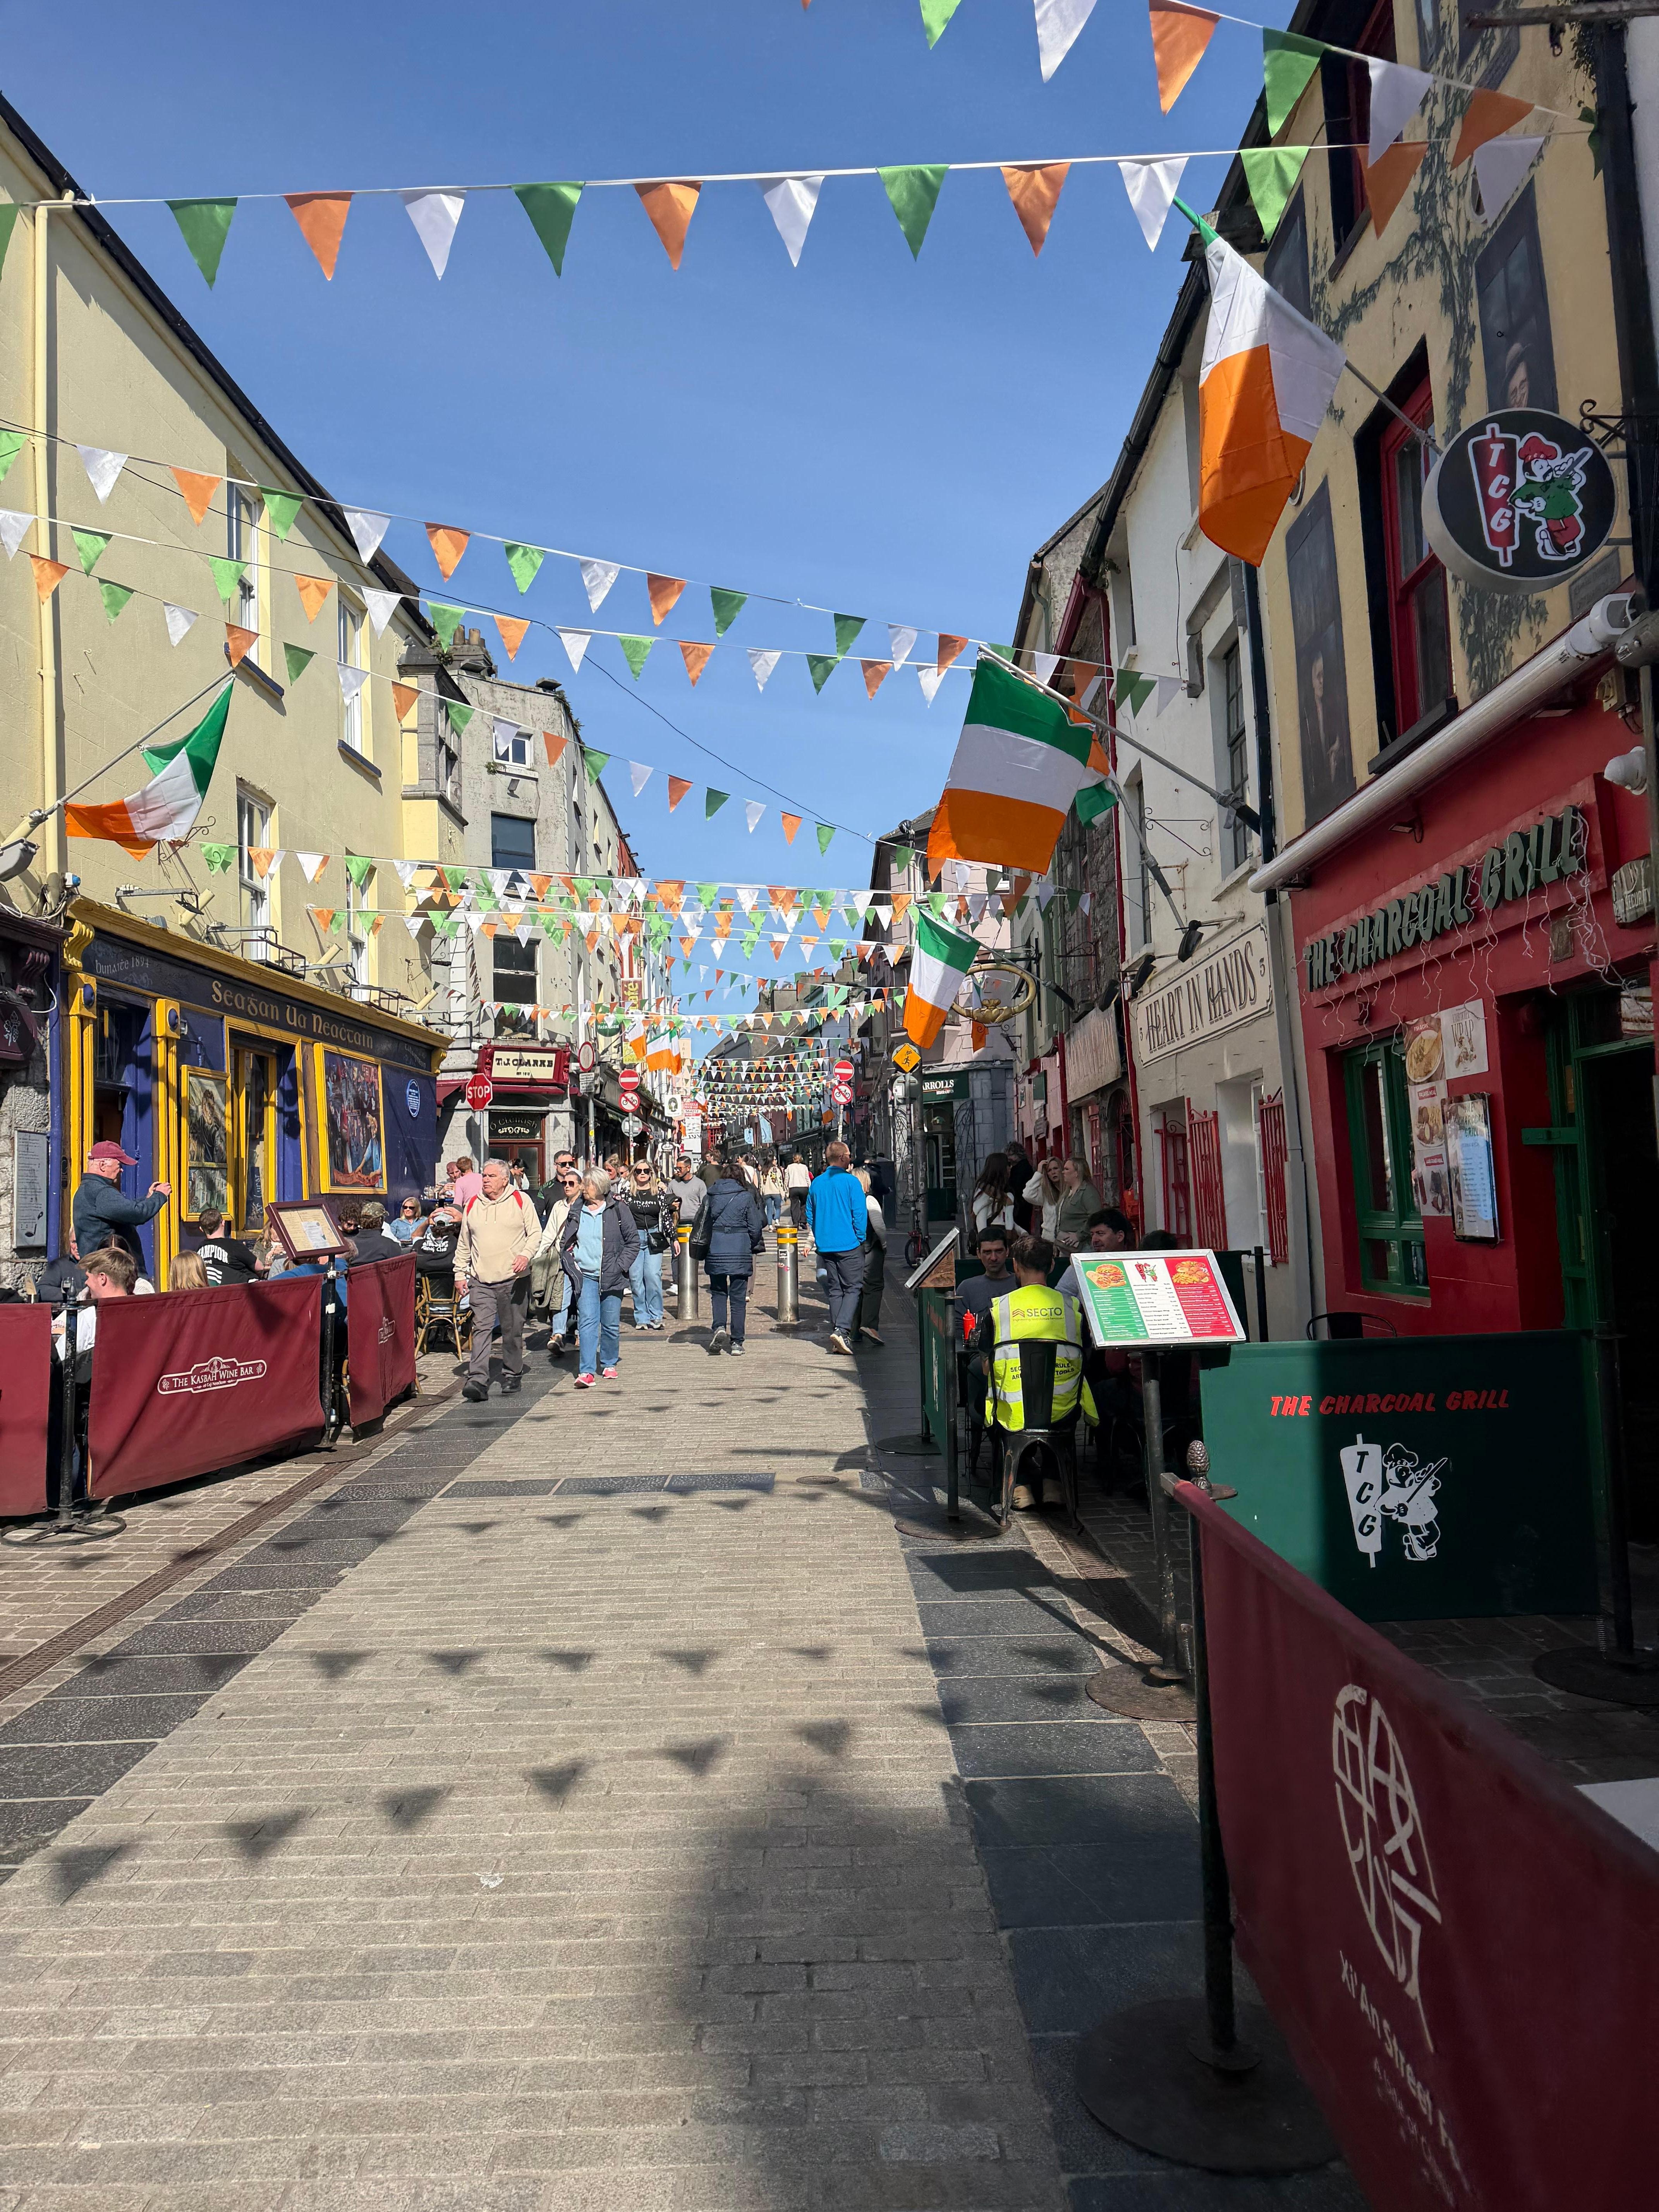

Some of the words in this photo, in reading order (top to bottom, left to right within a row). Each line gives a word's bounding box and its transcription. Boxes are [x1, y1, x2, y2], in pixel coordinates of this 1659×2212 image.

[1305, 931, 1337, 992] THE
[1342, 865, 1472, 974] CHARCOAL
[1480, 805, 1579, 909] GRILL
[1259, 957, 1266, 977] 5
[1146, 986, 1186, 1054] HEART
[1186, 974, 1204, 1035] IN
[1204, 941, 1257, 1025] HANDS
[512, 1059, 553, 1067] CLARKE
[467, 1085, 490, 1099] STOP
[1027, 1307, 1062, 1317] SECTO
[172, 1377, 188, 1388] THE
[191, 1374, 217, 1386] KASBAH
[219, 1369, 238, 1379] WINE
[240, 1367, 253, 1376] BAR
[1271, 1396, 1312, 1417] THE
[1319, 1392, 1436, 1415] CHARCOAL
[1446, 1389, 1509, 1410] GRILL
[1382, 2018, 1433, 2126] Street
